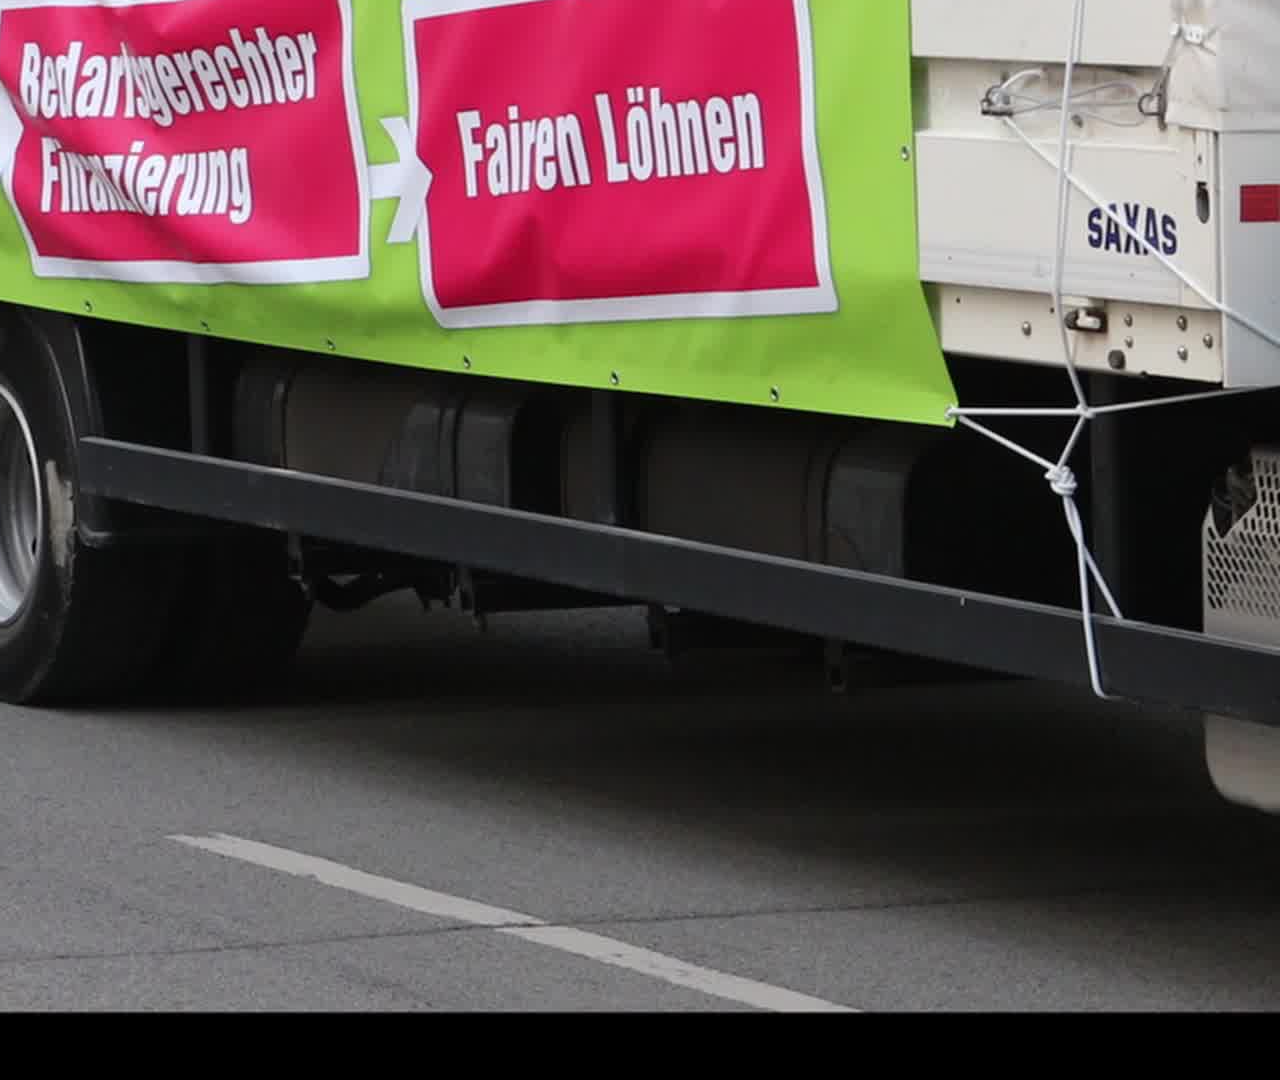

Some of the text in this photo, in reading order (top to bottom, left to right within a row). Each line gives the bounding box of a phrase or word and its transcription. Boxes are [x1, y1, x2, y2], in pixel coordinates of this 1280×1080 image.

[456, 85, 765, 198] Fairen Löhnen
[1088, 203, 1177, 256] SAXAS
